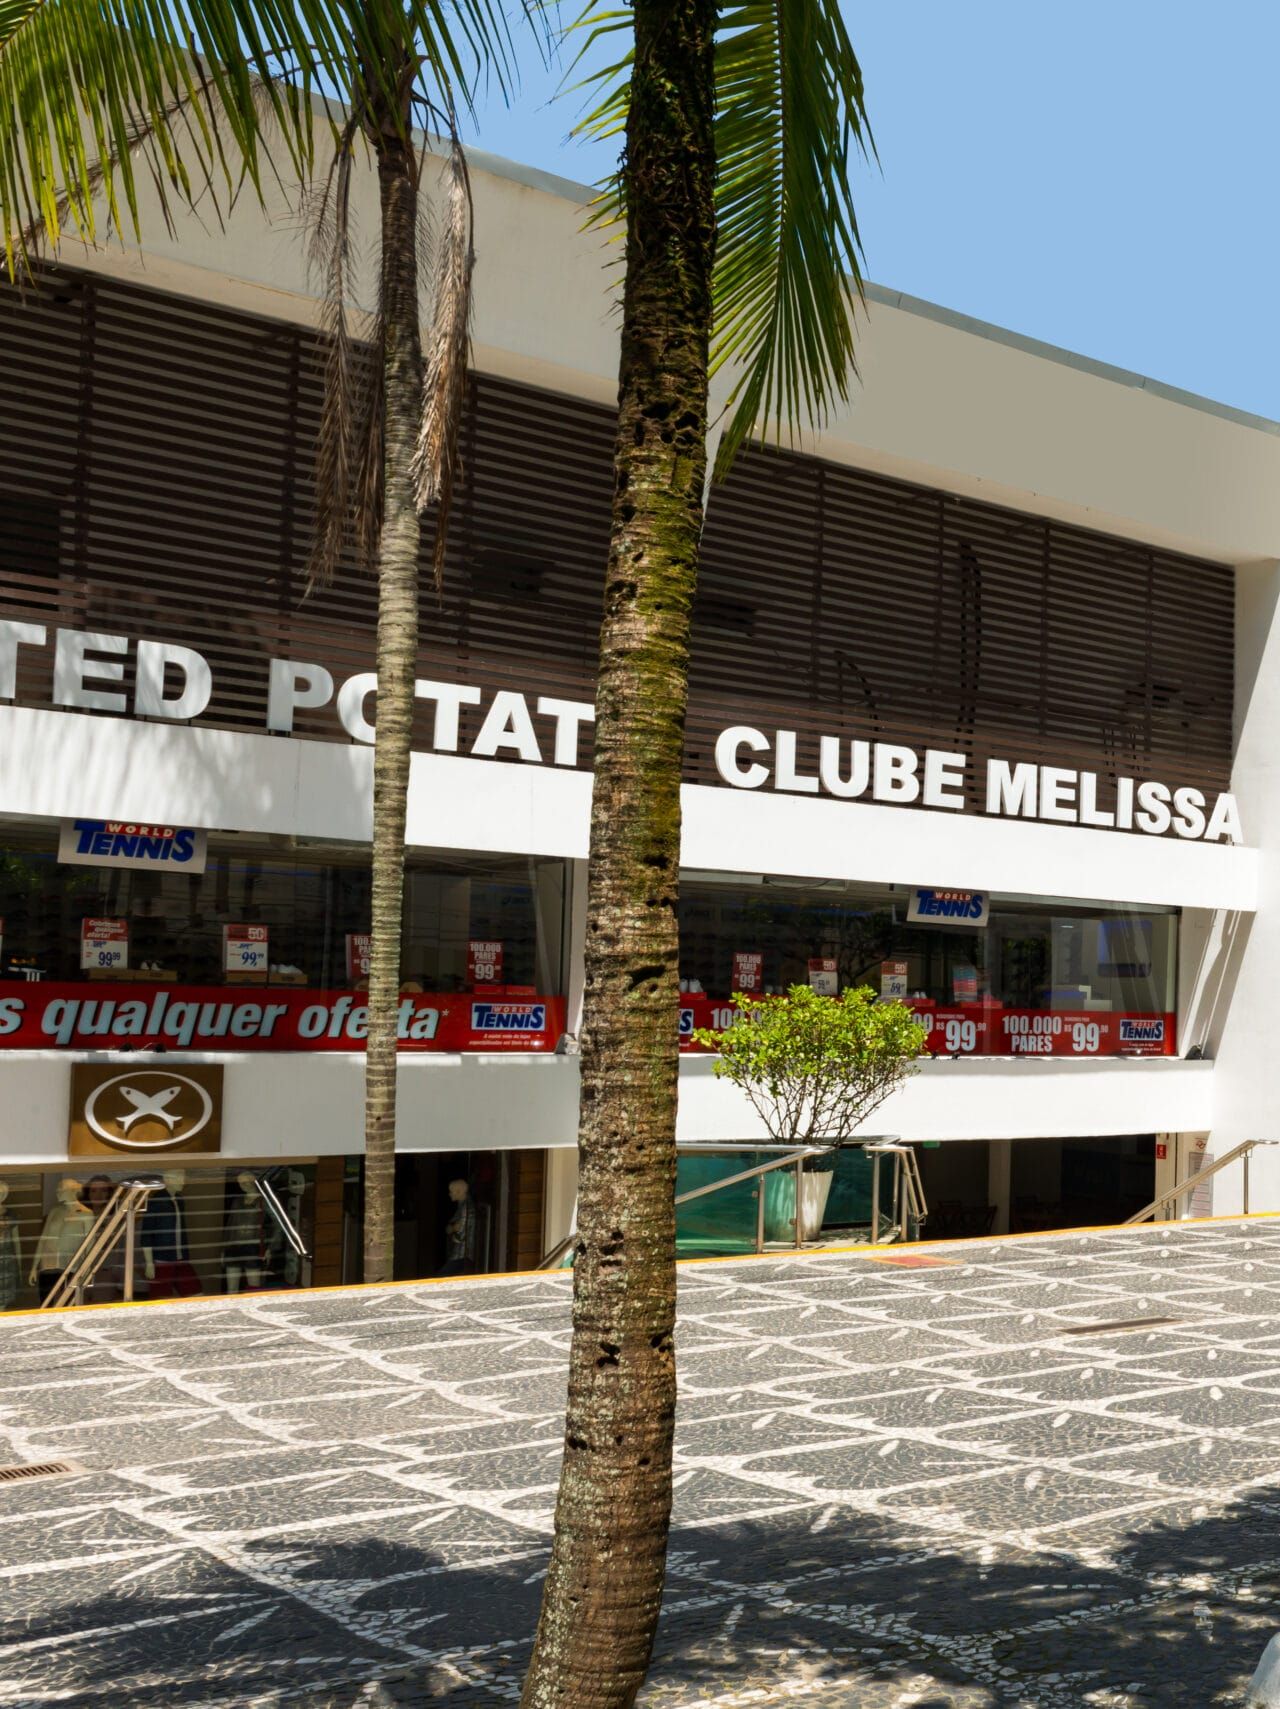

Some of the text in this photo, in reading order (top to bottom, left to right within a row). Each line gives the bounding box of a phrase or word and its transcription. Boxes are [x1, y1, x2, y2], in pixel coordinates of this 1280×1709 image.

[266, 658, 596, 767] POTAT
[714, 725, 1245, 844] CLUBE MELISSA
[73, 818, 196, 862] TENNIS
[108, 822, 174, 838] WORLD
[916, 888, 984, 918] TENNIS
[934, 891, 972, 900] WORLD
[354, 937, 371, 946] 100.
[41, 992, 288, 1046] qualquer
[298, 996, 450, 1040] ofeta
[473, 1005, 545, 1029] TENNIS
[1002, 1015, 1062, 1035] 100.000
[1121, 1021, 1163, 1040] TENNIS
[1011, 1035, 1053, 1052] PARES
